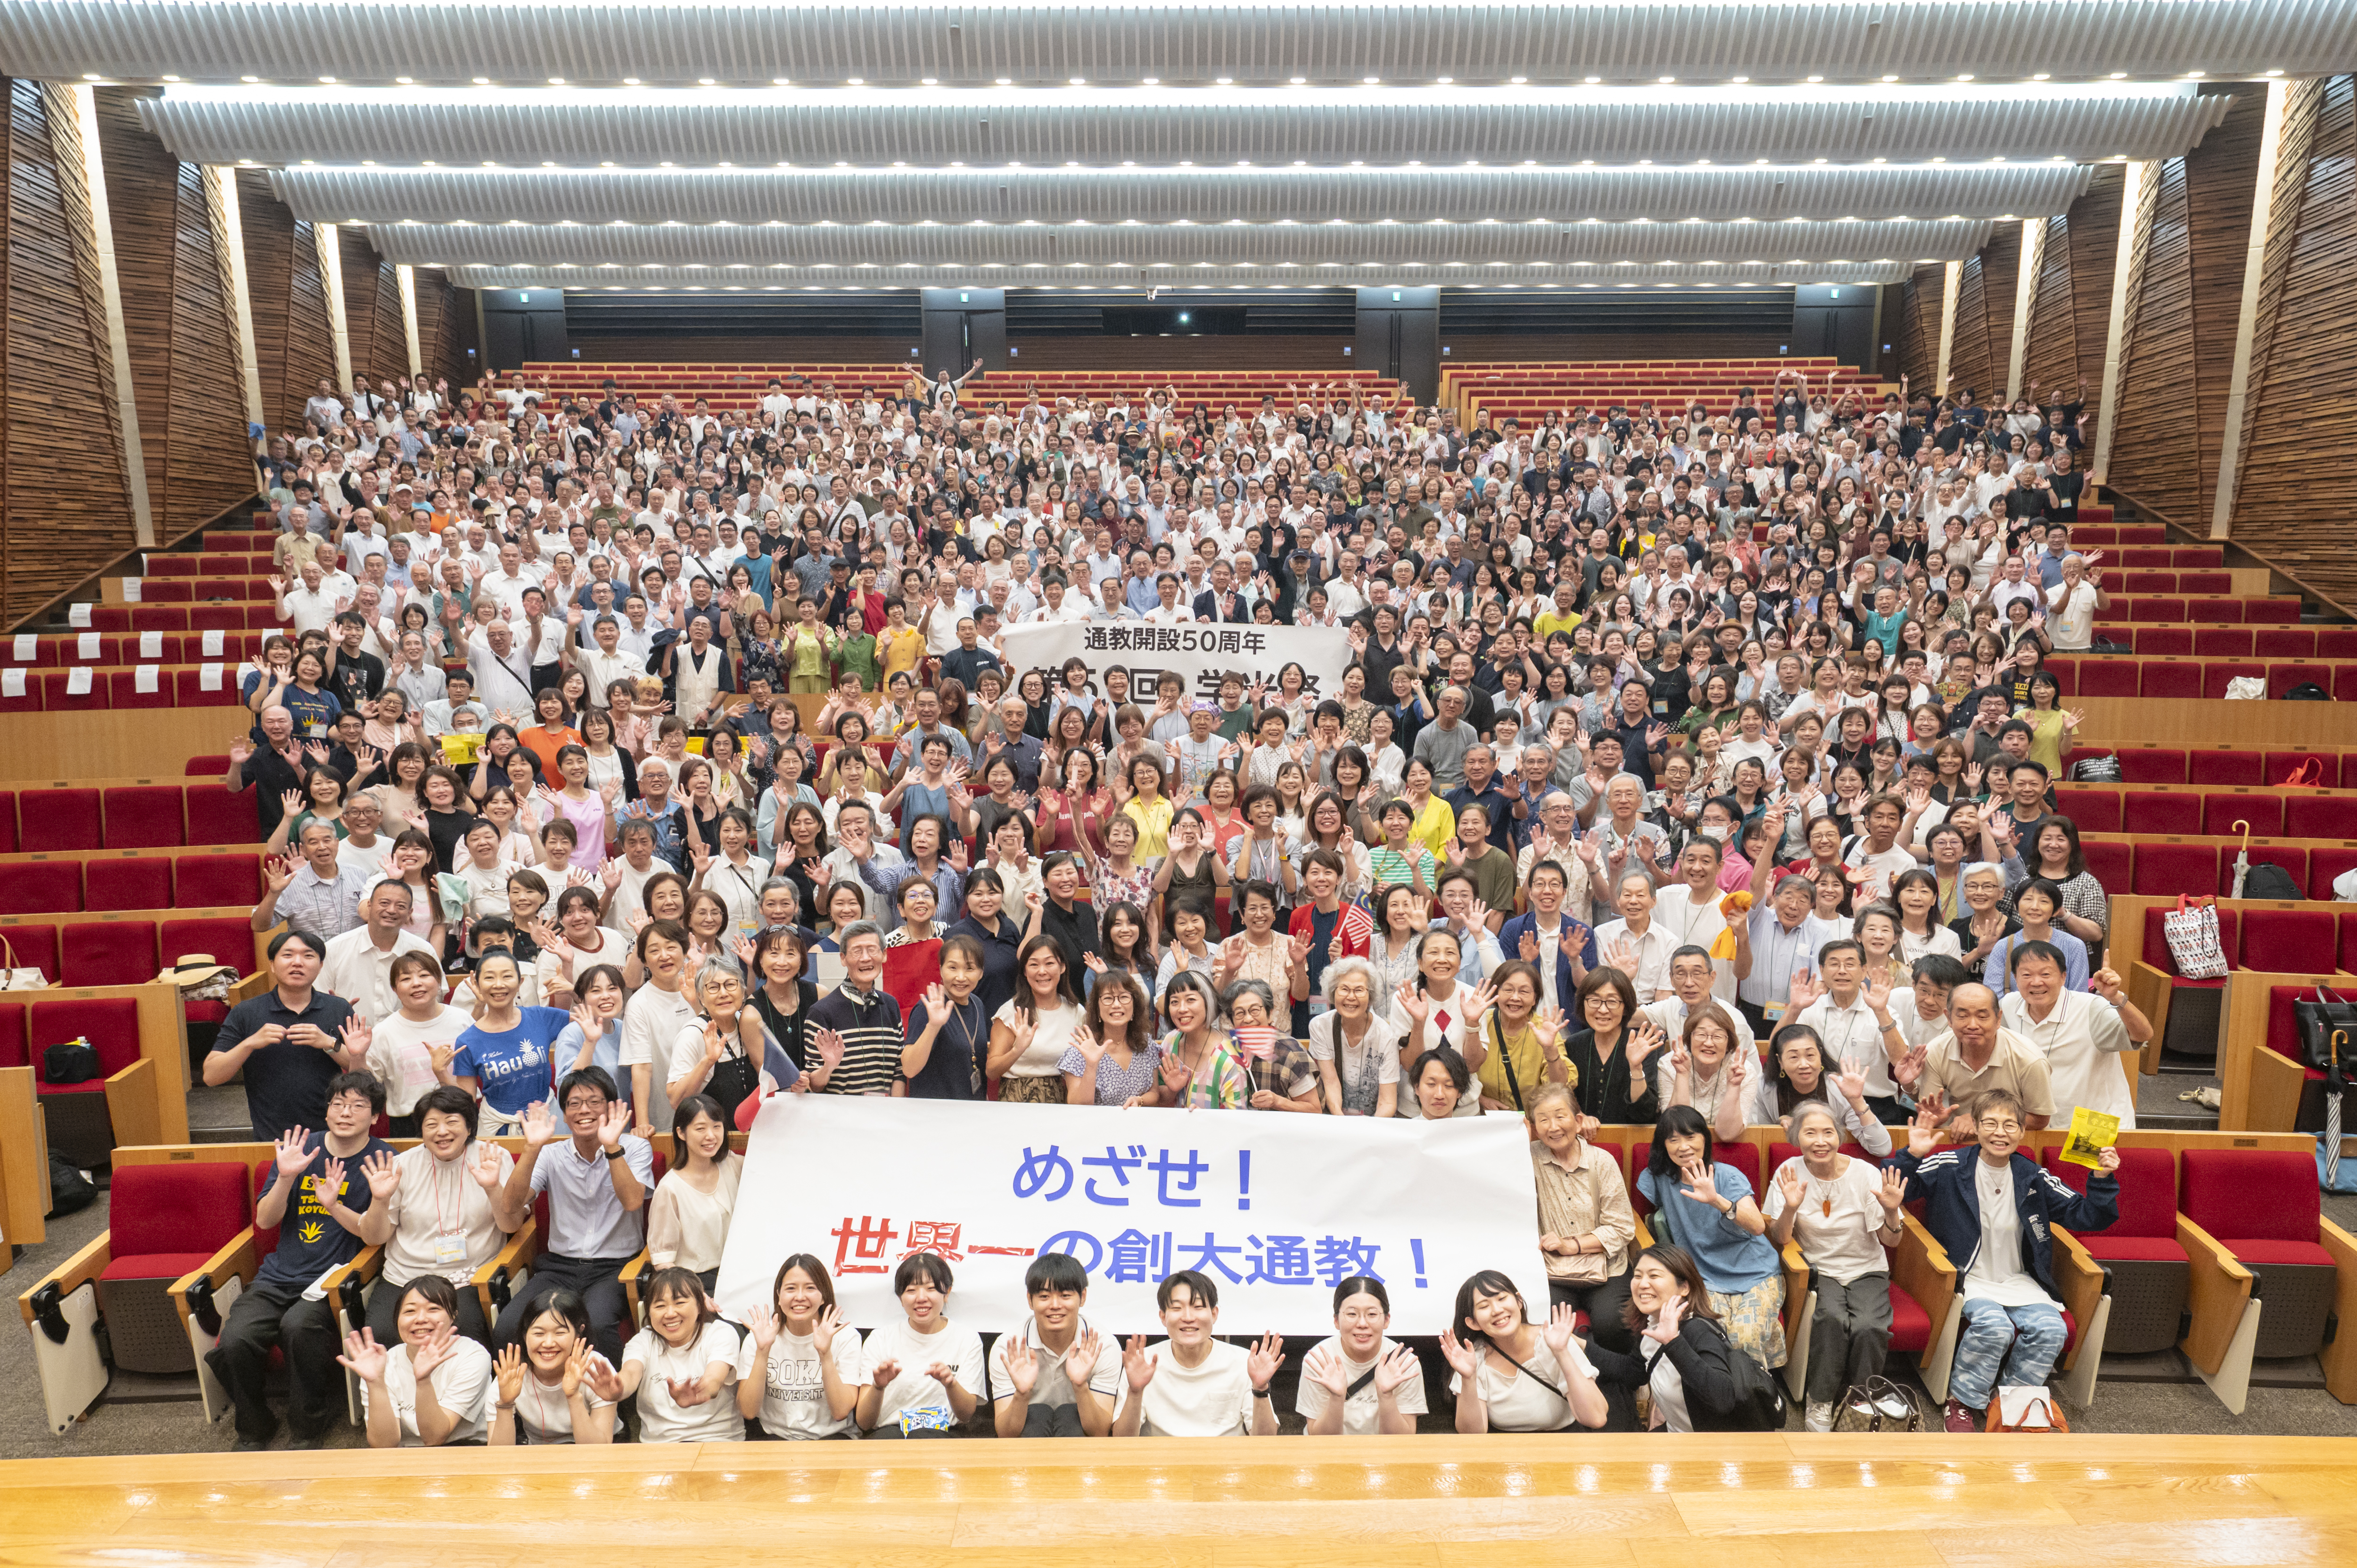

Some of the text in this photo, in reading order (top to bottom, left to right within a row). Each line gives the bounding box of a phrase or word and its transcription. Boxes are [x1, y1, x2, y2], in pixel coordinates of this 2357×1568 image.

[1084, 626, 1266, 655] 通教開設50周年
[1013, 1145, 1251, 1210] めざせ！
[767, 1387, 824, 1401] NIVERSIT
